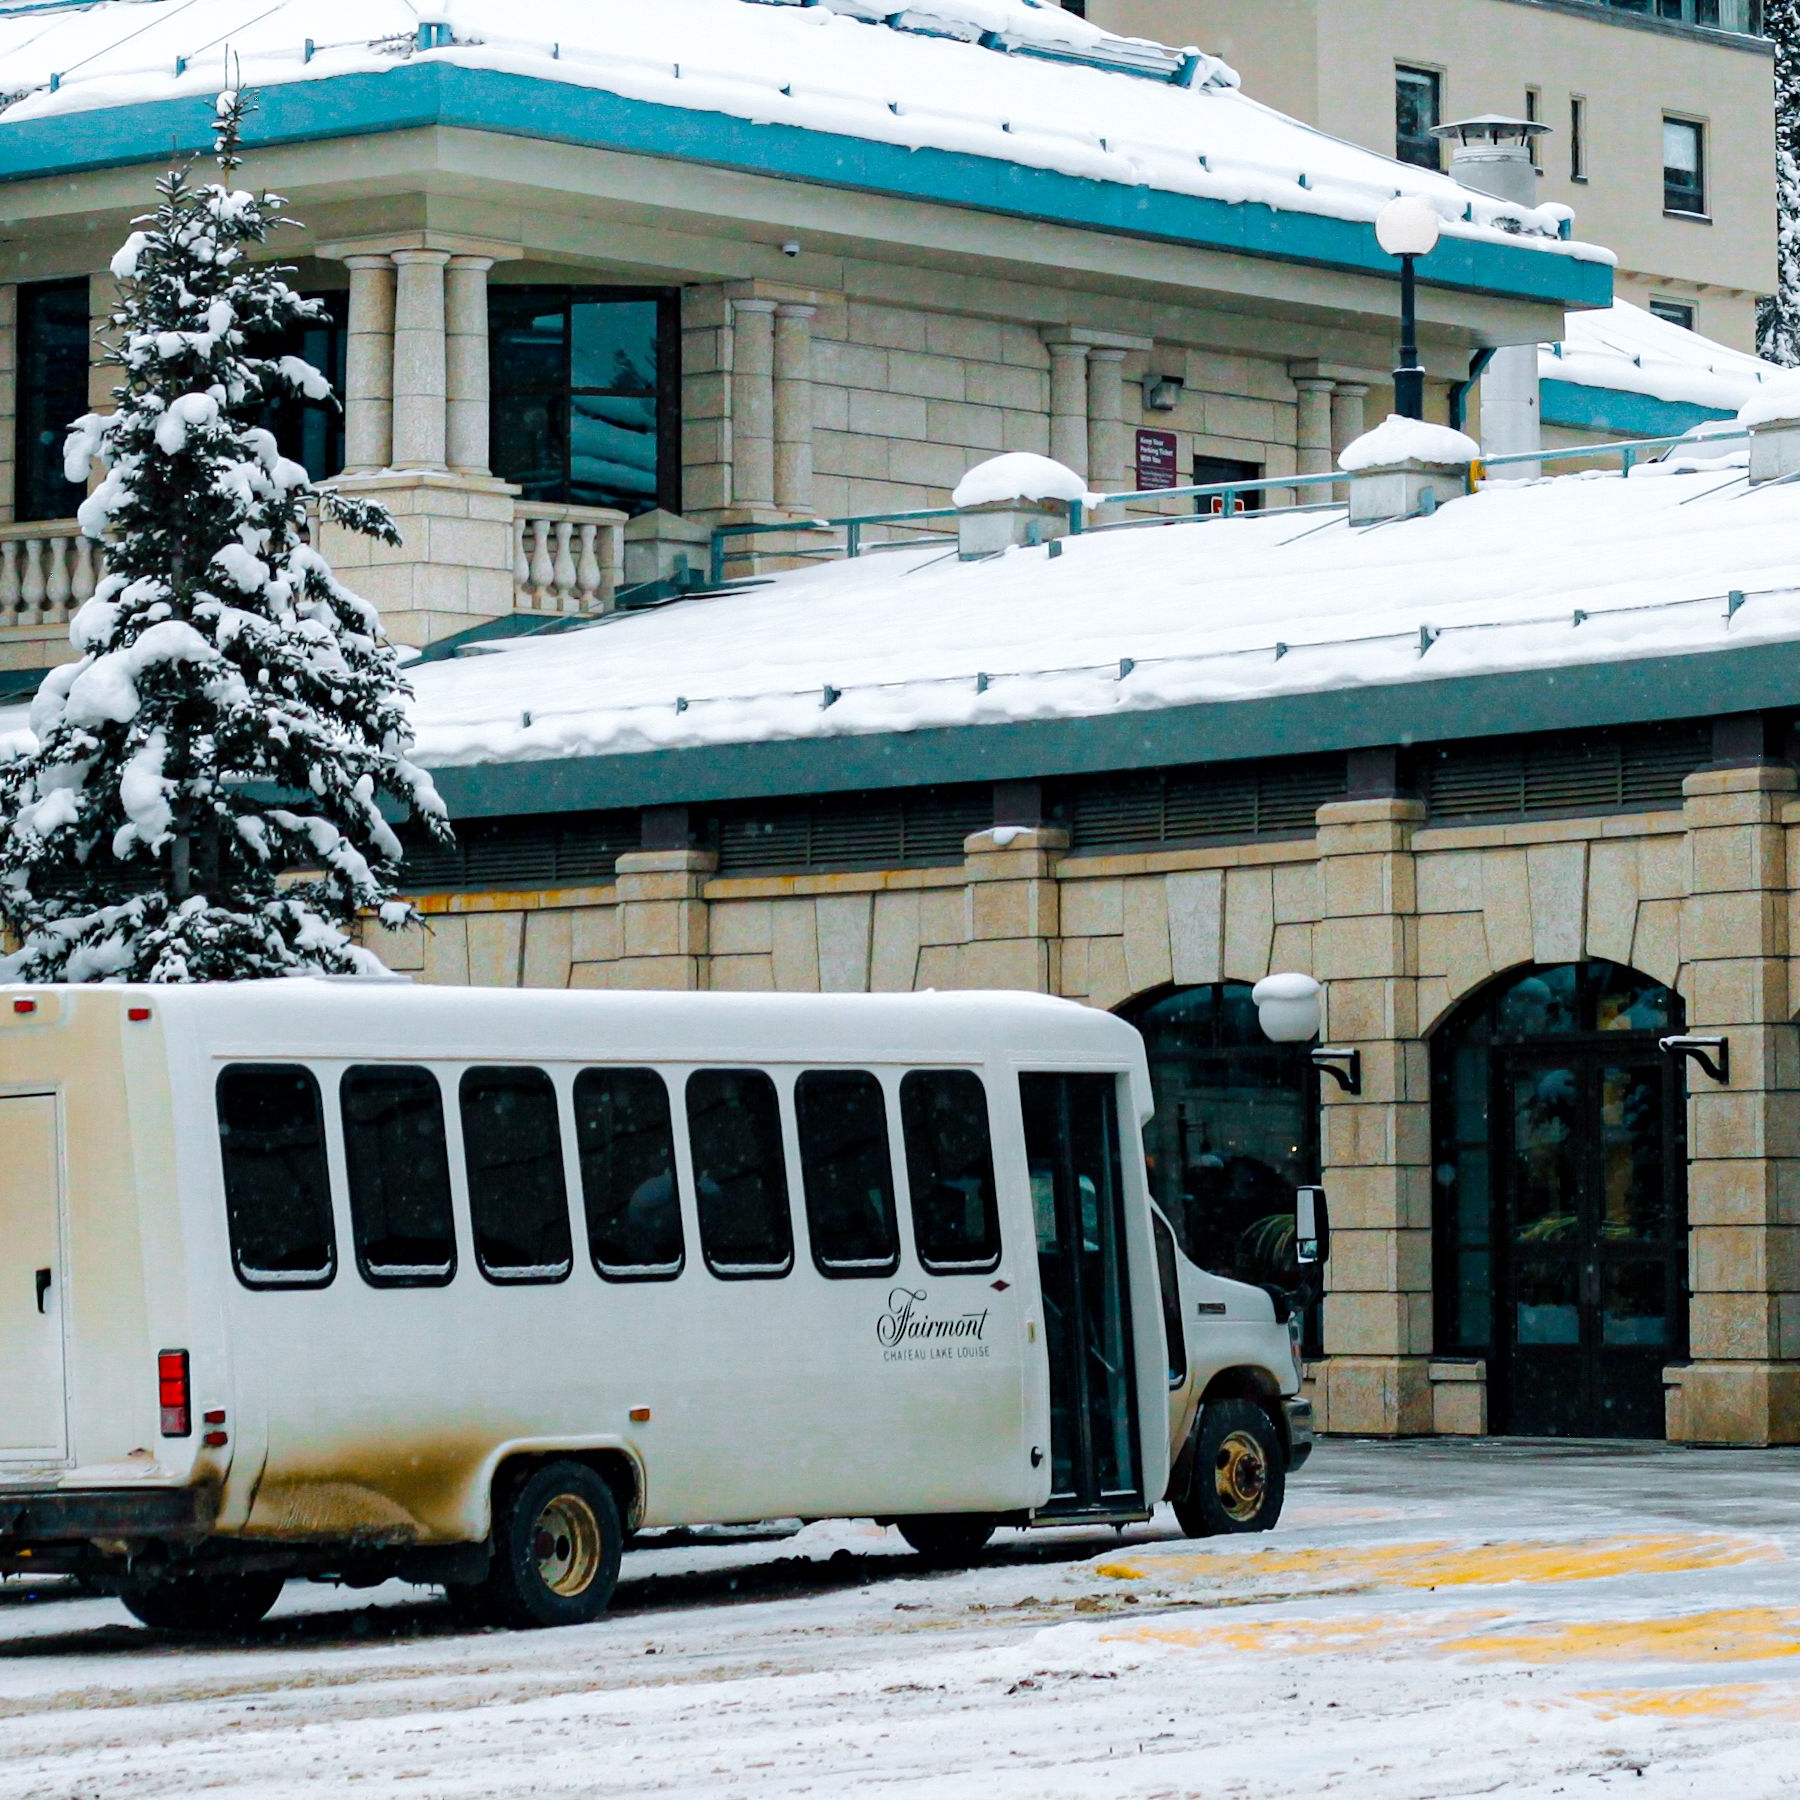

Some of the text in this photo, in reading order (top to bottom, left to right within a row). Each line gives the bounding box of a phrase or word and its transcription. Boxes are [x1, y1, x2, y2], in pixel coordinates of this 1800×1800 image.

[876, 1287, 991, 1348] Fairmont
[883, 1346, 990, 1362] CHATEAU LAKE LOUISE
